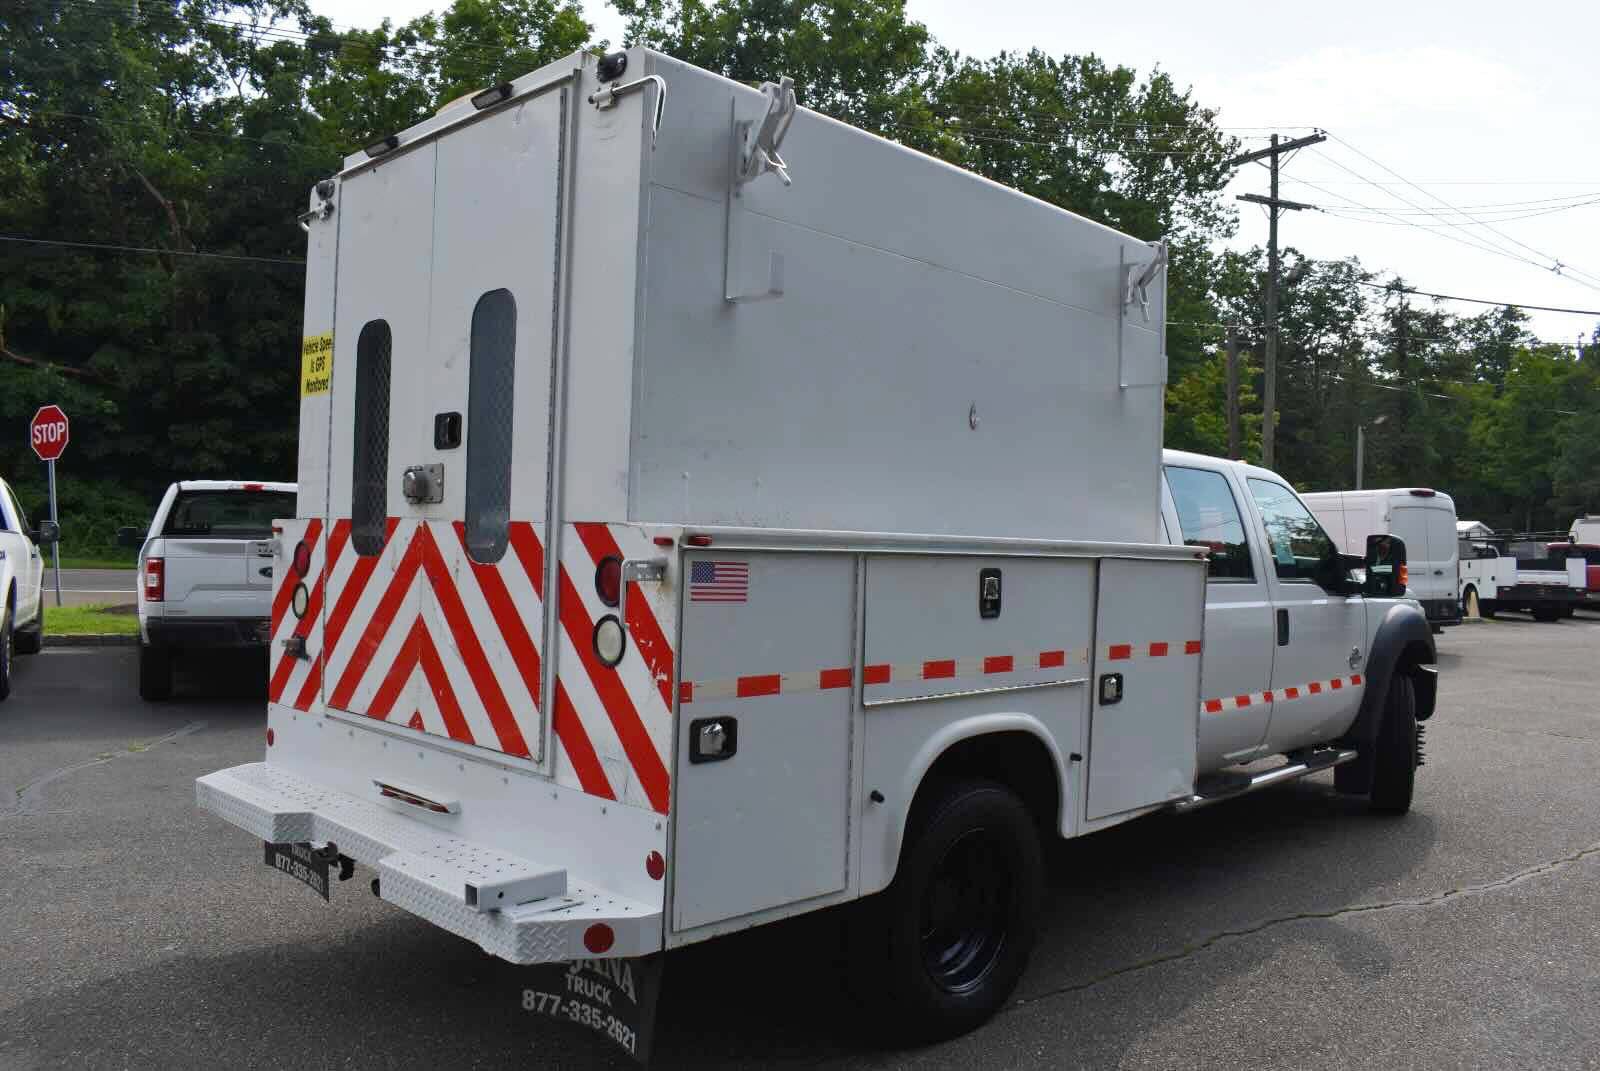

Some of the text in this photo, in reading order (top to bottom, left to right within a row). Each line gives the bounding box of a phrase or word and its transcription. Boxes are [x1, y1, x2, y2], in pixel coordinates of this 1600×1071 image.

[315, 355, 326, 372] GPS
[305, 376, 329, 394] Monitored
[33, 422, 66, 444] STOP
[565, 973, 612, 1006] TRUCK
[522, 989, 636, 1056] 877-335-2621
